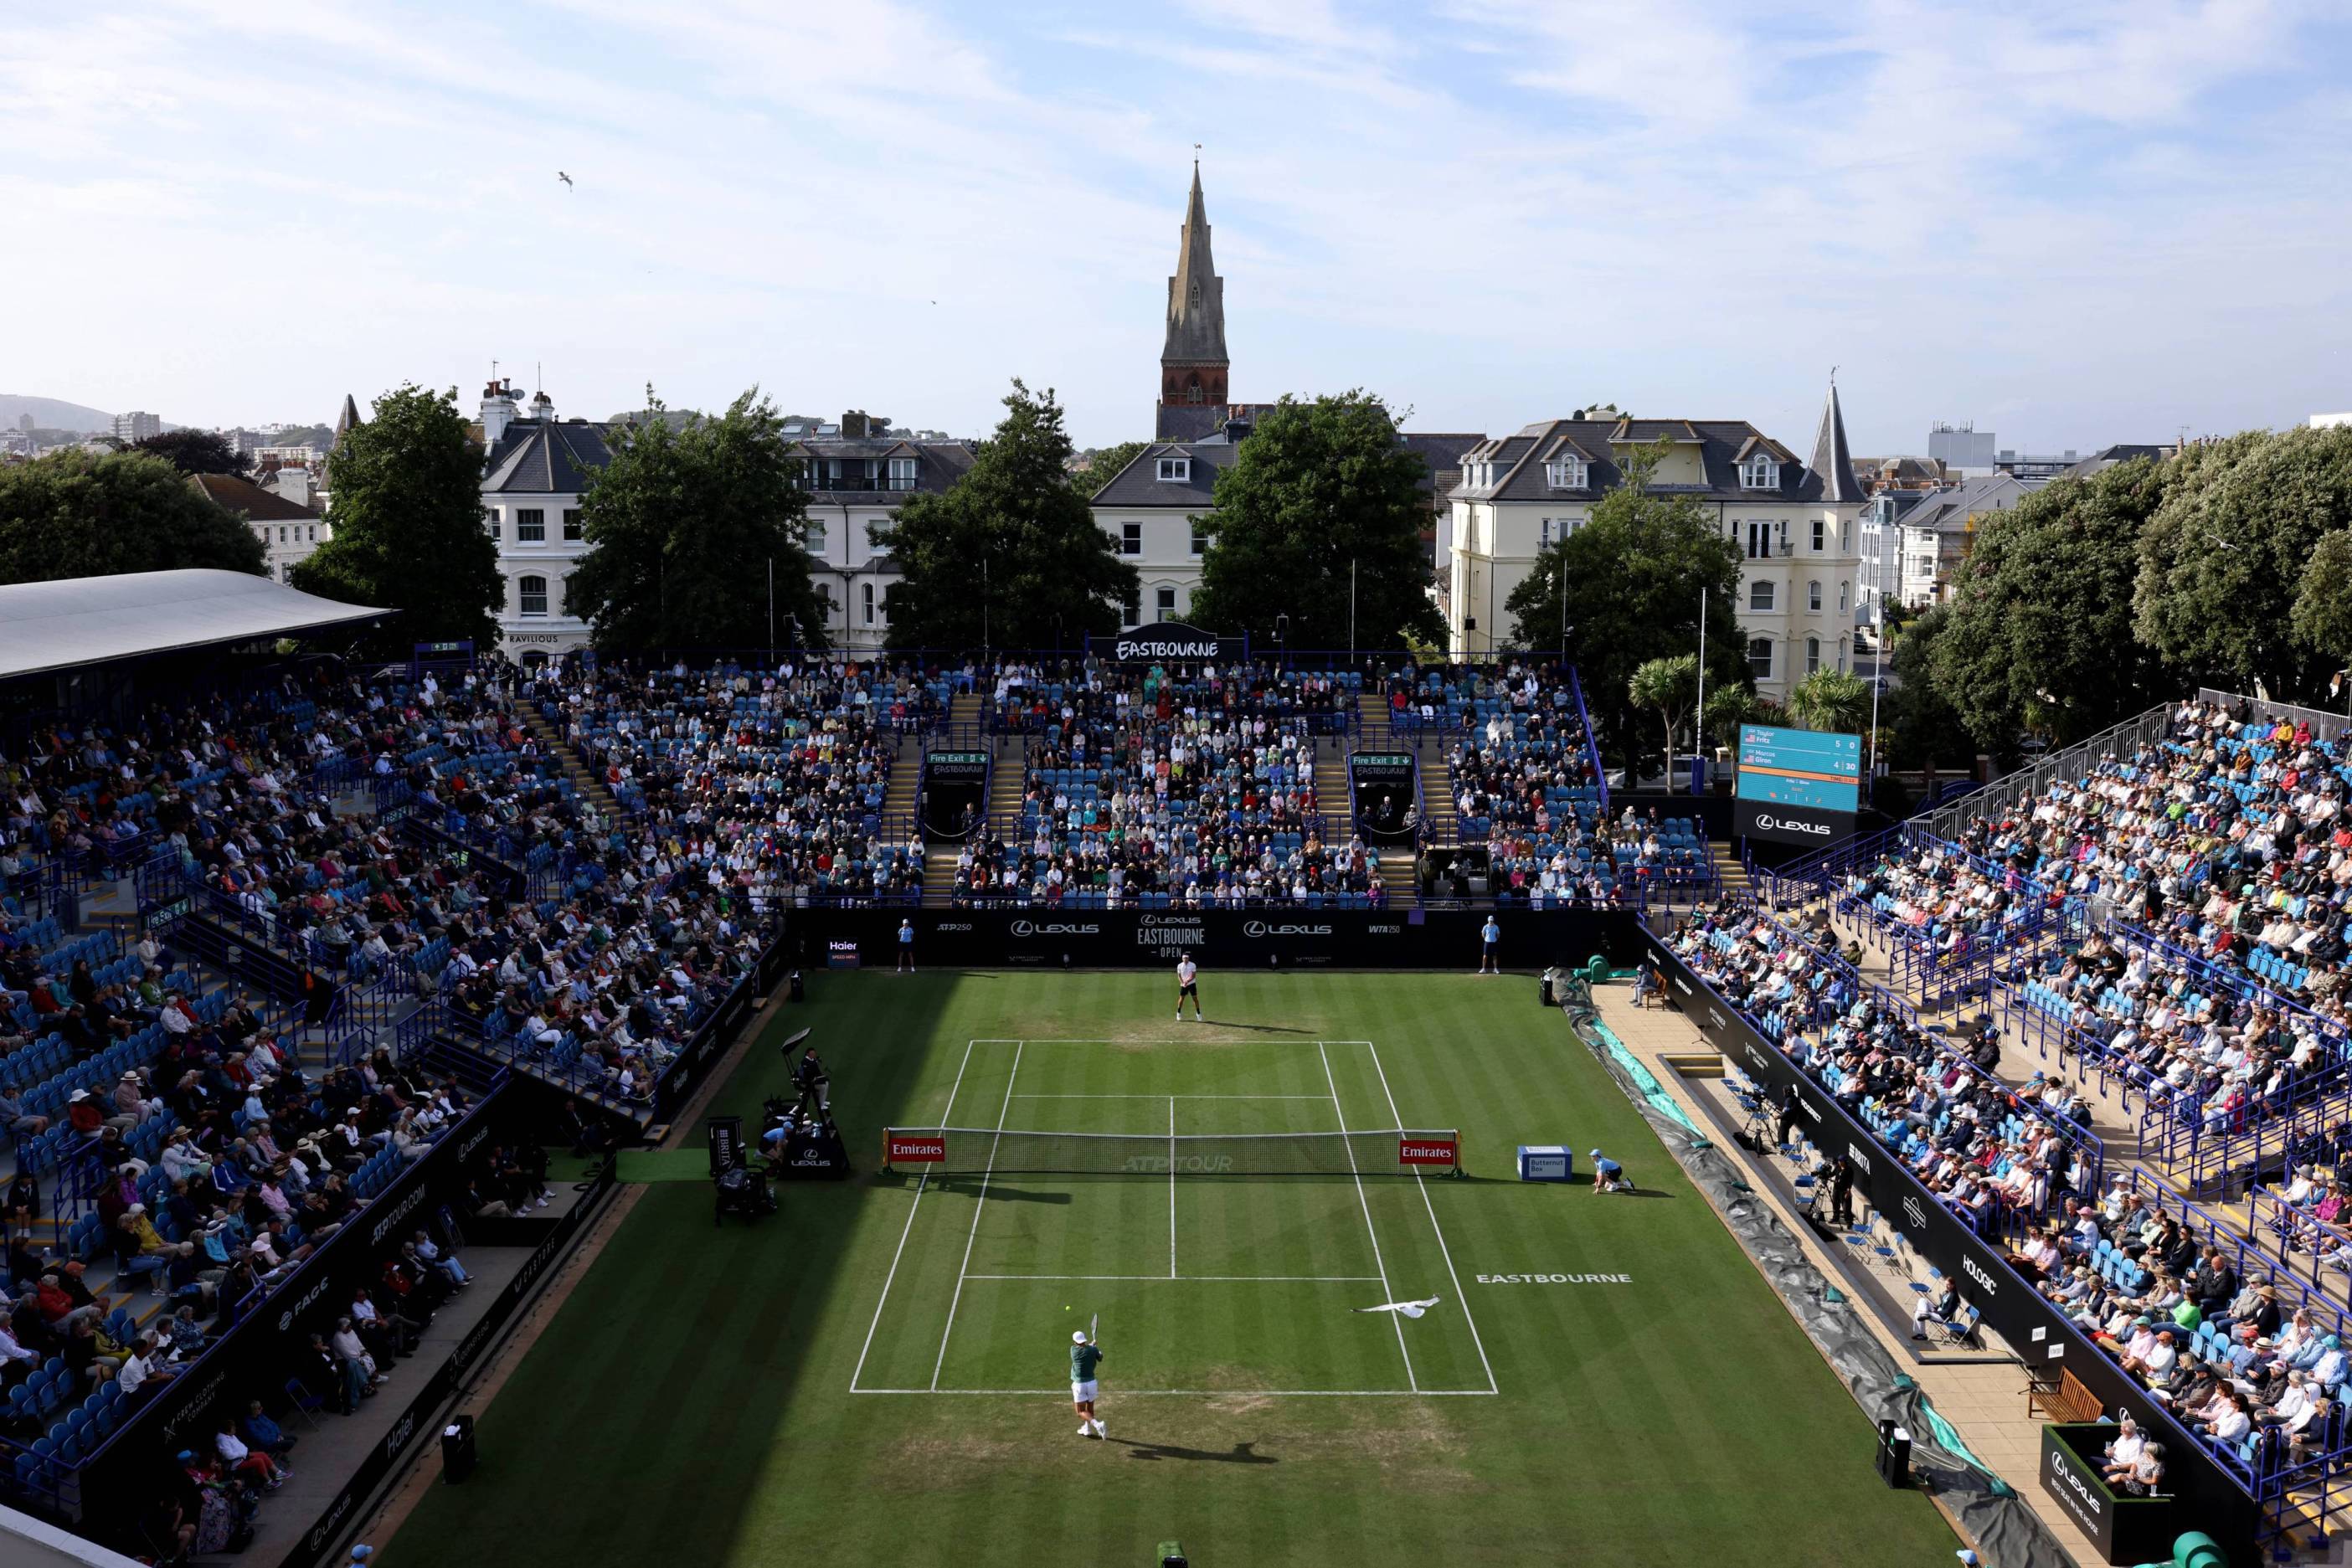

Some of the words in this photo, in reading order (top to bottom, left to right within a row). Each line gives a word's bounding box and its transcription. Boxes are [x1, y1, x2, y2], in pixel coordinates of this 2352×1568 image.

[1116, 640, 1218, 661] EASTBOURNE
[934, 764, 983, 774] EASTBOURNE
[1356, 767, 1406, 776] EASTBOURNE
[1776, 819, 1830, 835] LEXUS
[1035, 923, 1099, 933] LEXUS
[1138, 928, 1205, 944] EASTBOURNE
[1268, 924, 1332, 934] LEXUS
[830, 941, 857, 950] Haier
[1161, 947, 1181, 958] OPEN
[466, 1125, 489, 1152] LEXUS
[721, 1139, 730, 1165] BRITA
[893, 1144, 943, 1154] Emirates
[1402, 1147, 1452, 1158] Emirates
[1855, 1147, 1871, 1175] BRITA
[1476, 1274, 1634, 1283] EASTBOURNE
[1963, 1254, 1995, 1296] HOLOGIC
[295, 1276, 329, 1316] FAGE
[177, 1399, 193, 1421] CREW
[195, 1370, 224, 1404] CLOTHING
[387, 1411, 414, 1459] Haier
[2065, 1467, 2100, 1514] LEXUS
[323, 1493, 352, 1535] LEXUS
[2051, 1477, 2061, 1493] BEST
[2061, 1488, 2070, 1504] SEAT
[2070, 1499, 2076, 1510] IN
[2083, 1514, 2099, 1536] HOUSE
